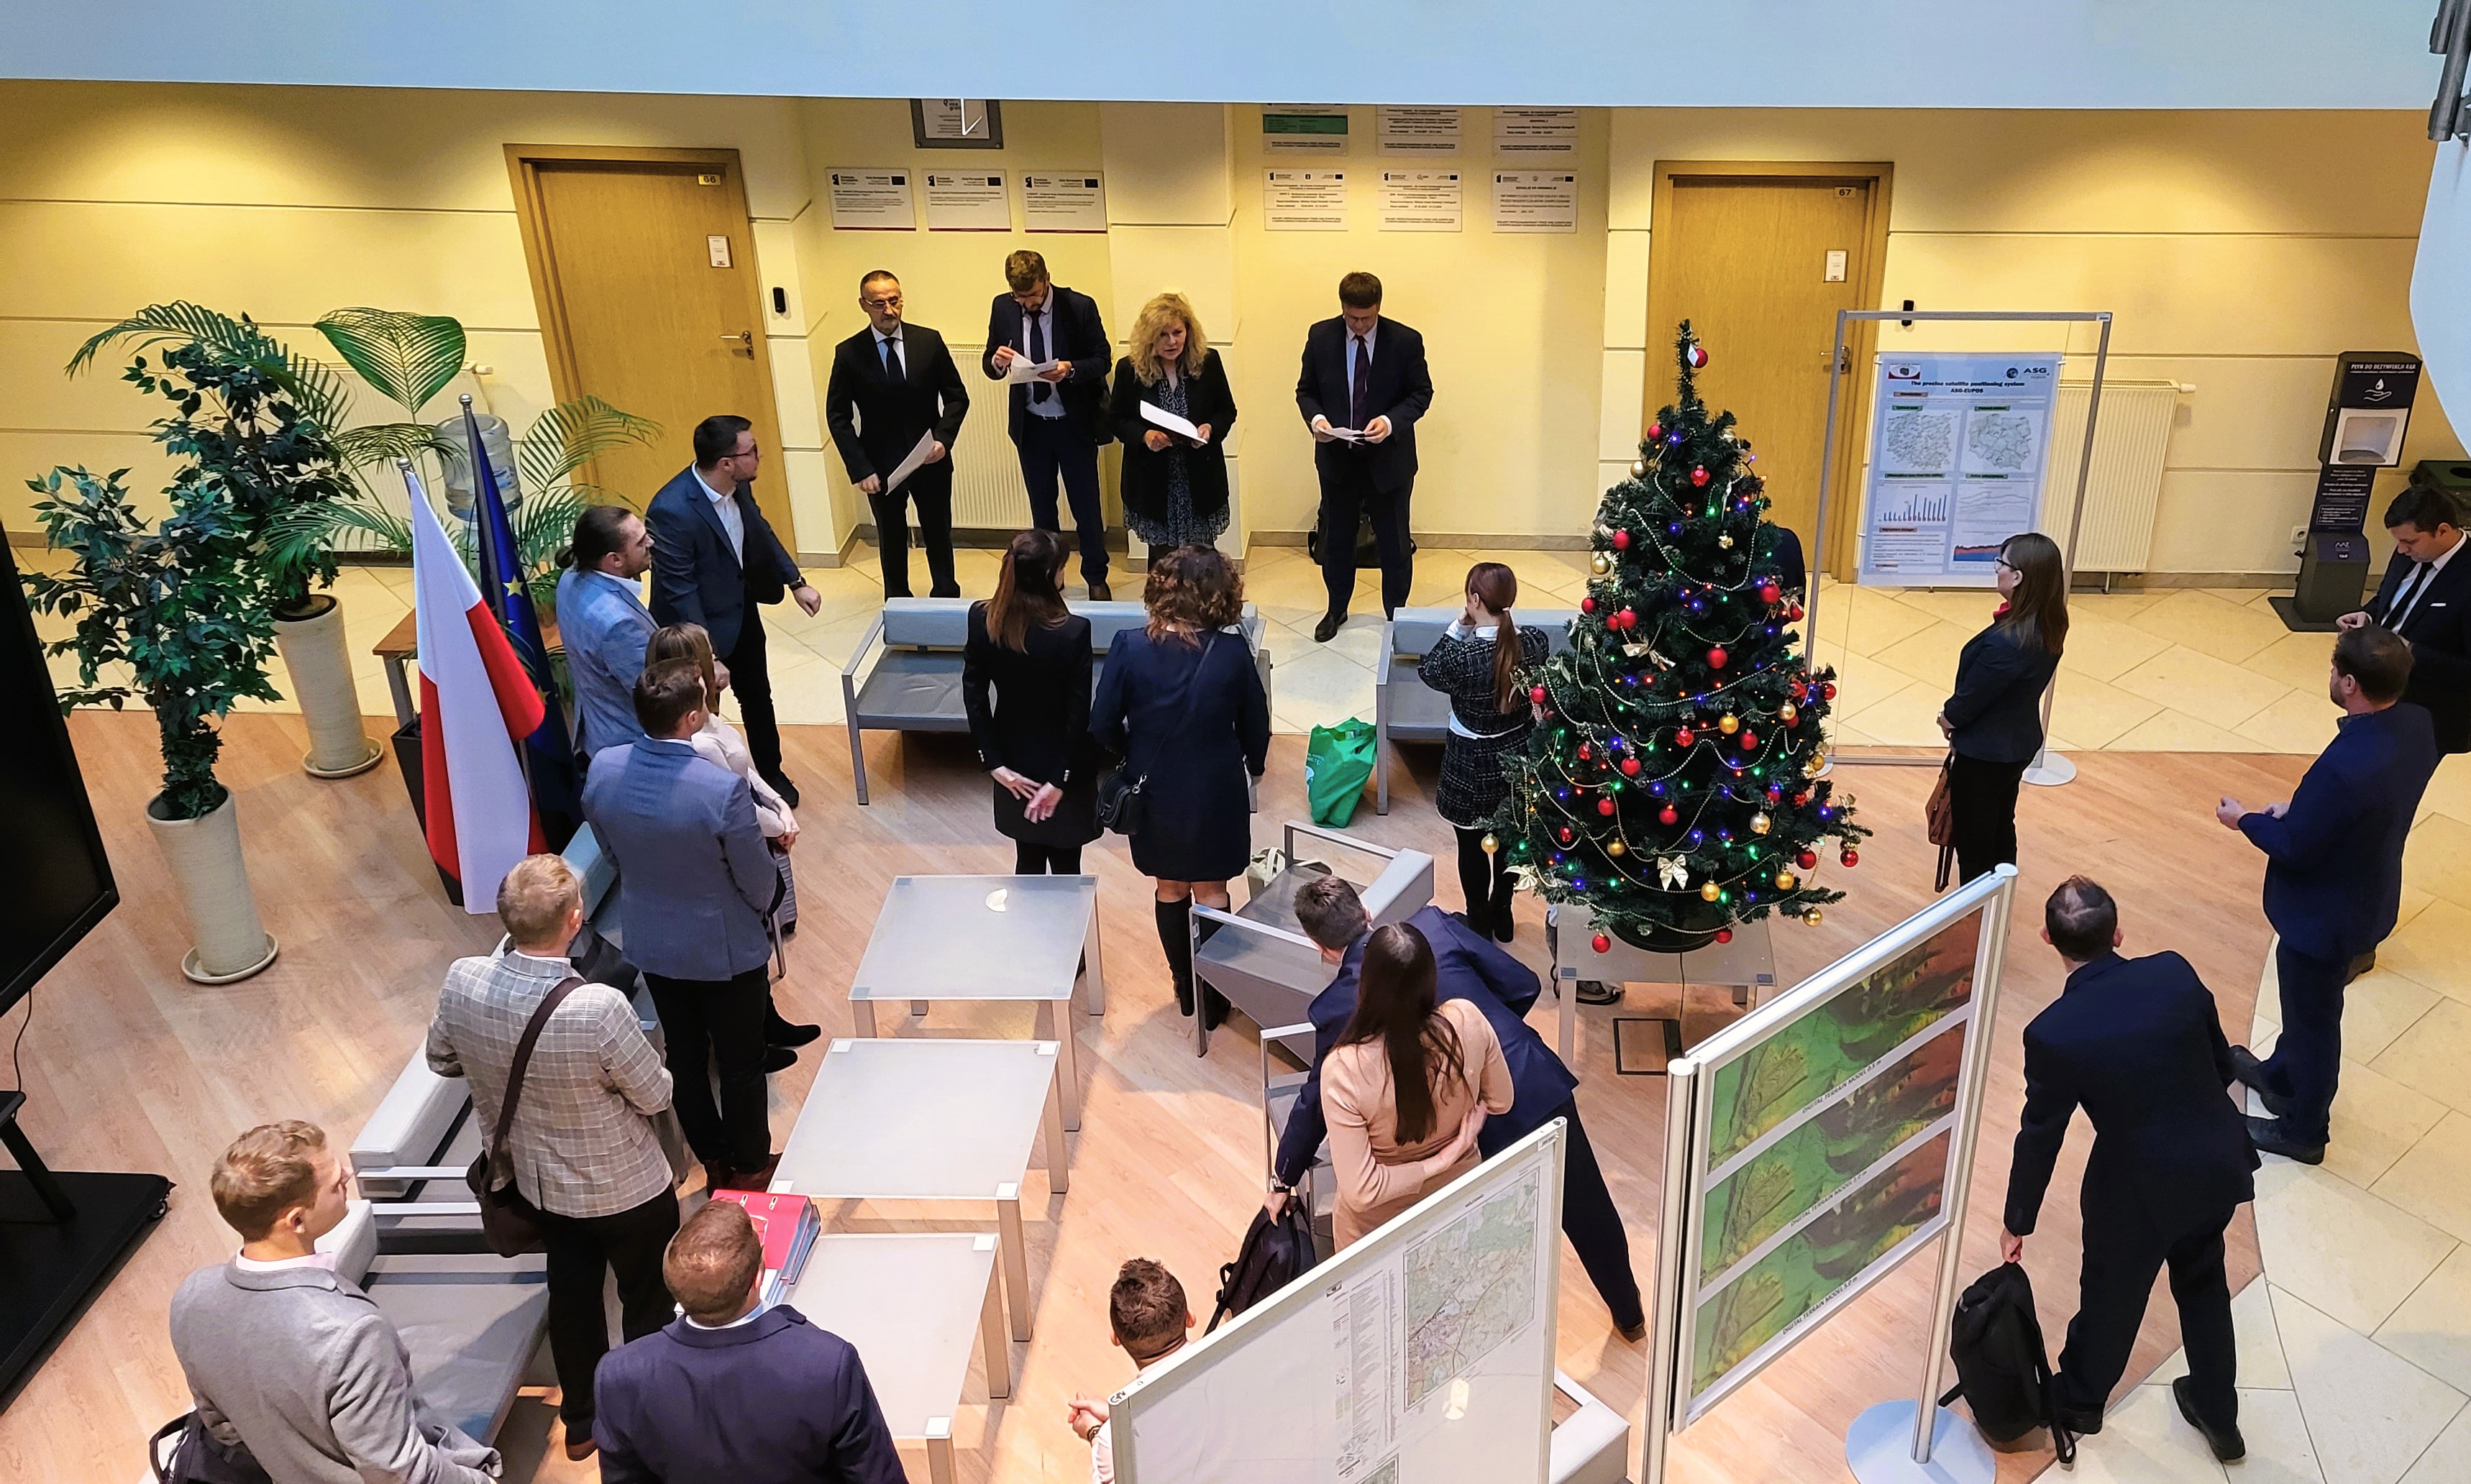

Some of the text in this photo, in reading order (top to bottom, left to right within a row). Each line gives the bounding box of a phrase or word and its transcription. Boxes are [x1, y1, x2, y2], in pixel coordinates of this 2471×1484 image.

[1802, 1099, 1824, 1114] DIGITAL
[1824, 1081, 1847, 1100] TERRAIN
[1847, 1071, 1866, 1085] MODEL
[1791, 1209, 1811, 1227] DIGITAL
[1812, 1194, 1833, 1212] TERRAIN
[1834, 1181, 1853, 1196] MODEL
[1783, 1317, 1803, 1335] DIGITAL
[1803, 1301, 1824, 1319] TERRAIN
[1825, 1286, 1843, 1301] MODEL
[1843, 1280, 1852, 1290] 5.0
